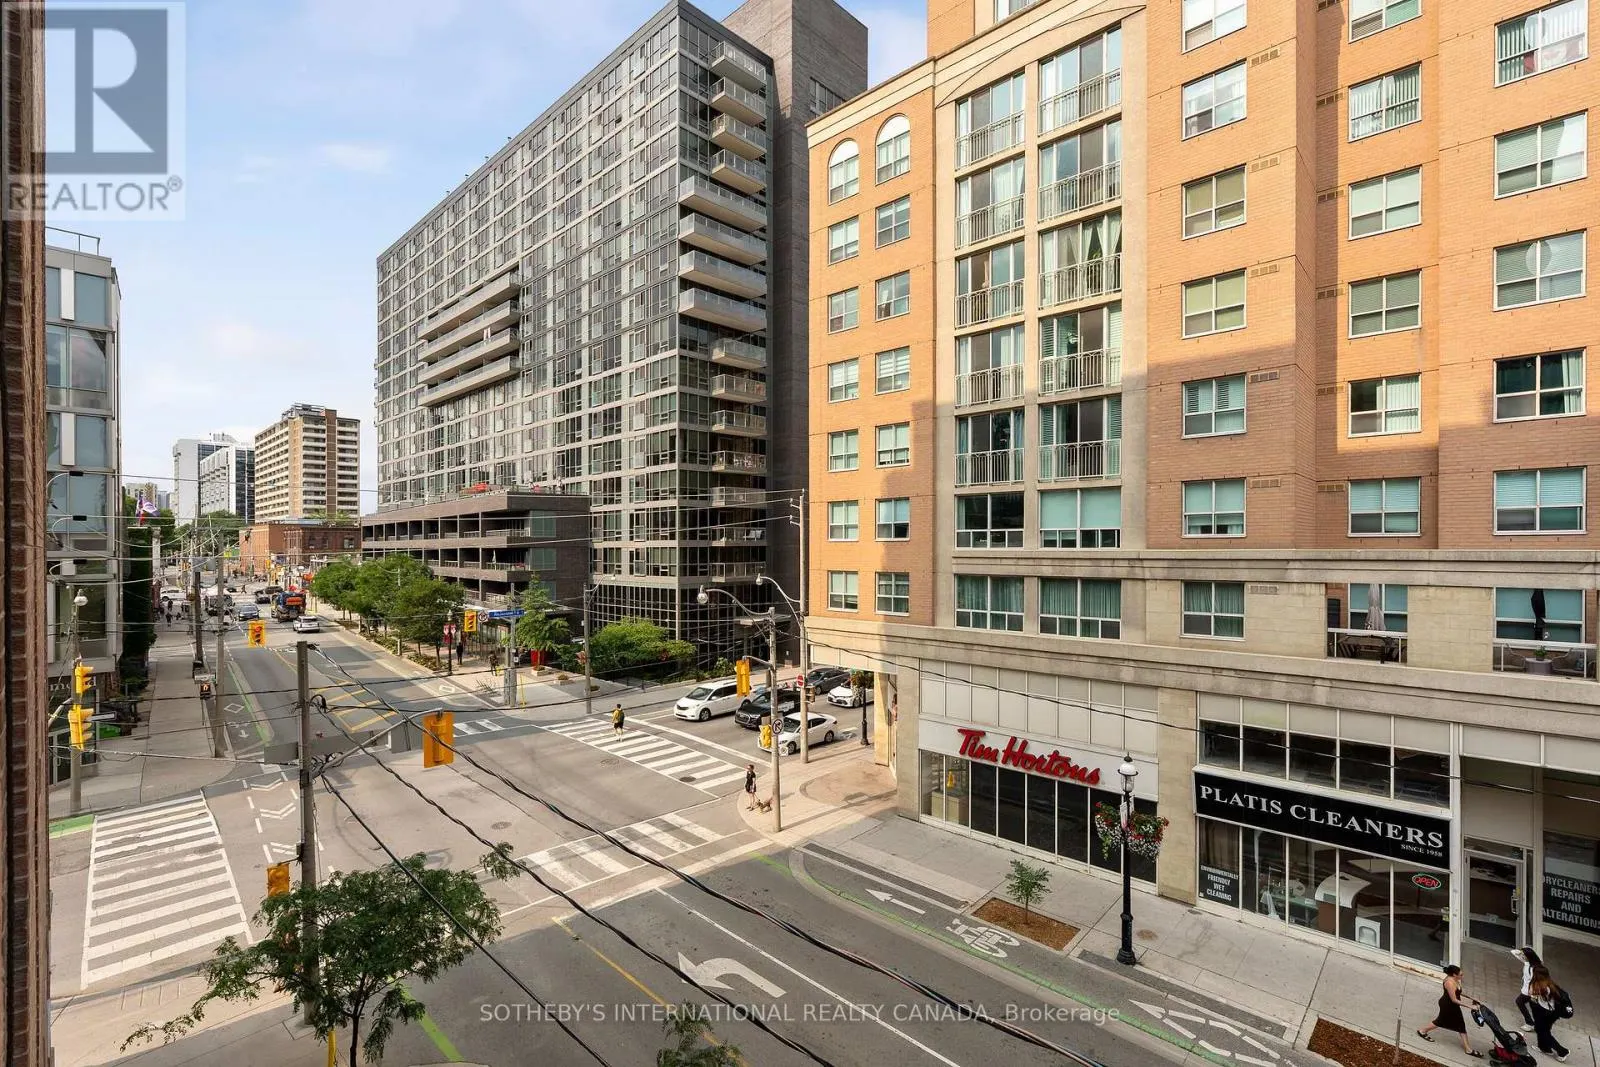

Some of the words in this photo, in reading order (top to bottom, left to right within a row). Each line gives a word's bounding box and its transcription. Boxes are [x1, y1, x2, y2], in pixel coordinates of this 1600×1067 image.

[957, 728, 999, 763] Tim
[1002, 735, 1101, 786] Hortons
[1200, 785, 1283, 815] PLATIS
[1289, 804, 1443, 848] CLEANERS
[1401, 843, 1425, 854] SINCE
[1207, 873, 1231, 886] FRIENDLY
[1414, 876, 1439, 888] OPEN
[1213, 882, 1225, 891] WET
[1206, 888, 1232, 901] CLEANING
[1550, 887, 1591, 904] REPAIRS
[1560, 900, 1582, 913] AND
